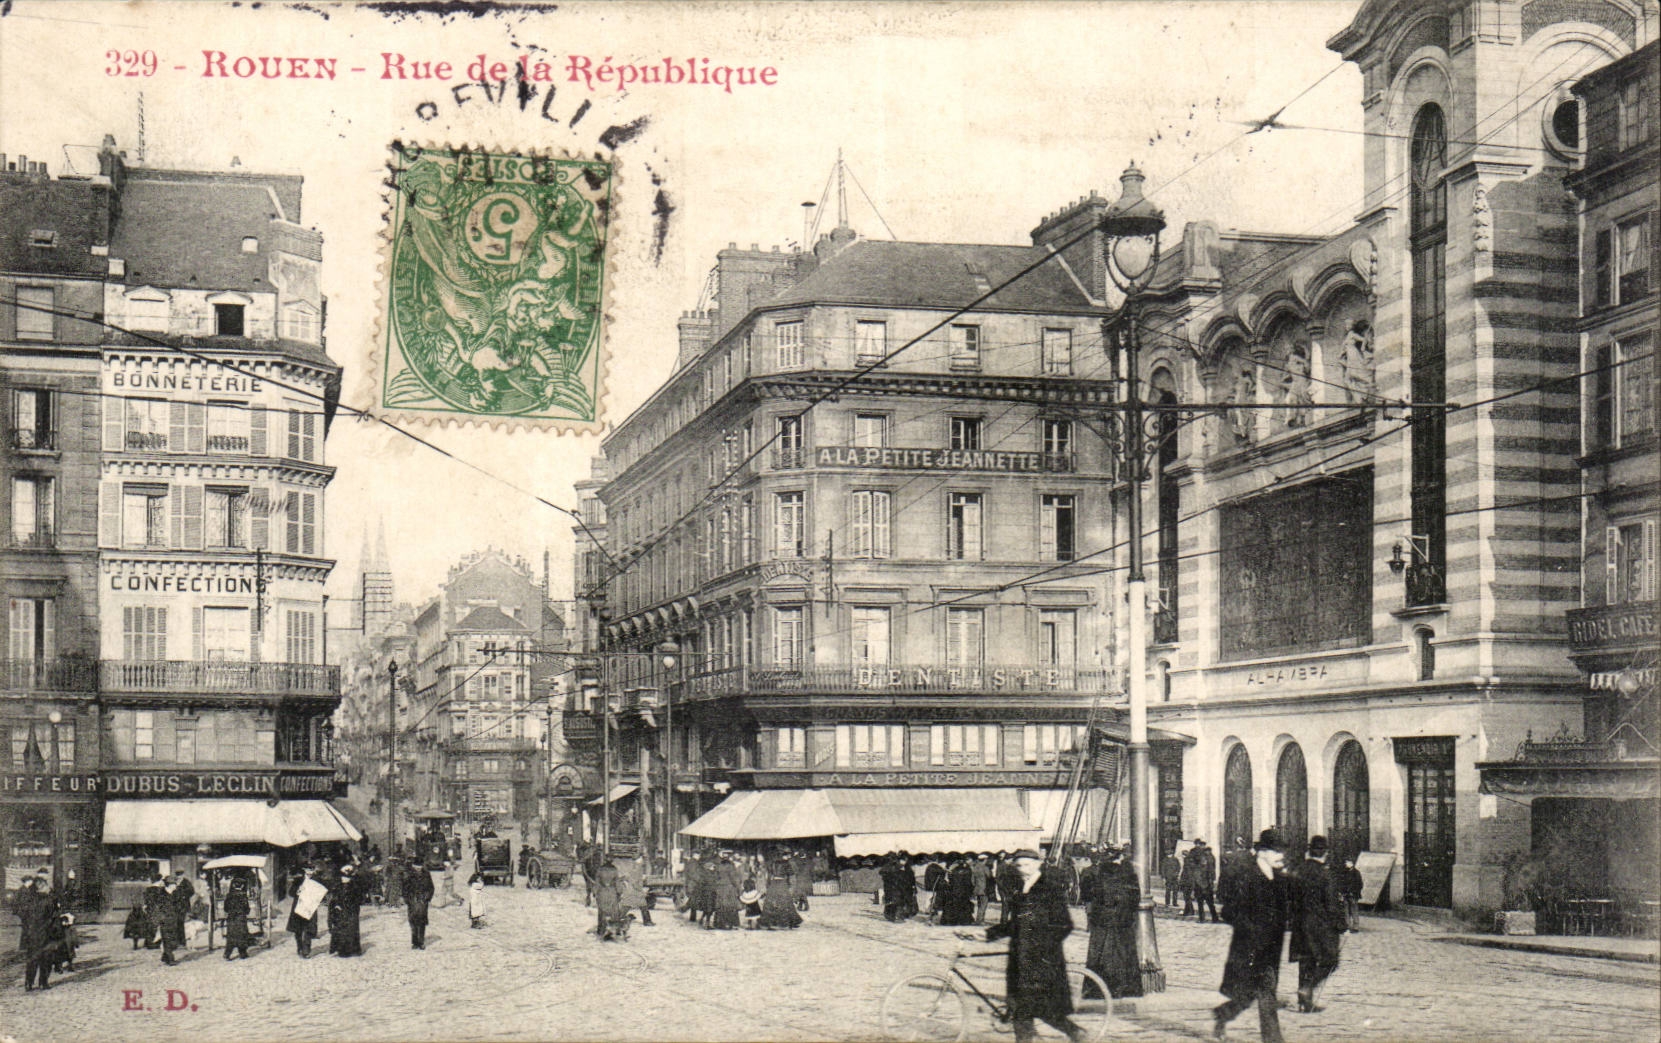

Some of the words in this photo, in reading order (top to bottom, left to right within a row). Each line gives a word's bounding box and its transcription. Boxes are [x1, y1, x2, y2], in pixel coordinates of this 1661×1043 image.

[482, 197, 521, 262] 5
[113, 372, 264, 393] BONNETERIE
[818, 448, 834, 465] A
[836, 448, 859, 465] LA
[863, 447, 933, 467] PETITE
[936, 449, 1040, 470] JEANNETTE
[110, 575, 267, 594] CONFECTIONS
[857, 668, 1061, 687] DENTISTE
[106, 775, 181, 794] DUBUS
[197, 775, 276, 794] LECLIN
[279, 776, 334, 792] CONFECTIONS
[827, 773, 844, 786] A
[851, 773, 877, 786] LA
[885, 773, 958, 786] PETITE
